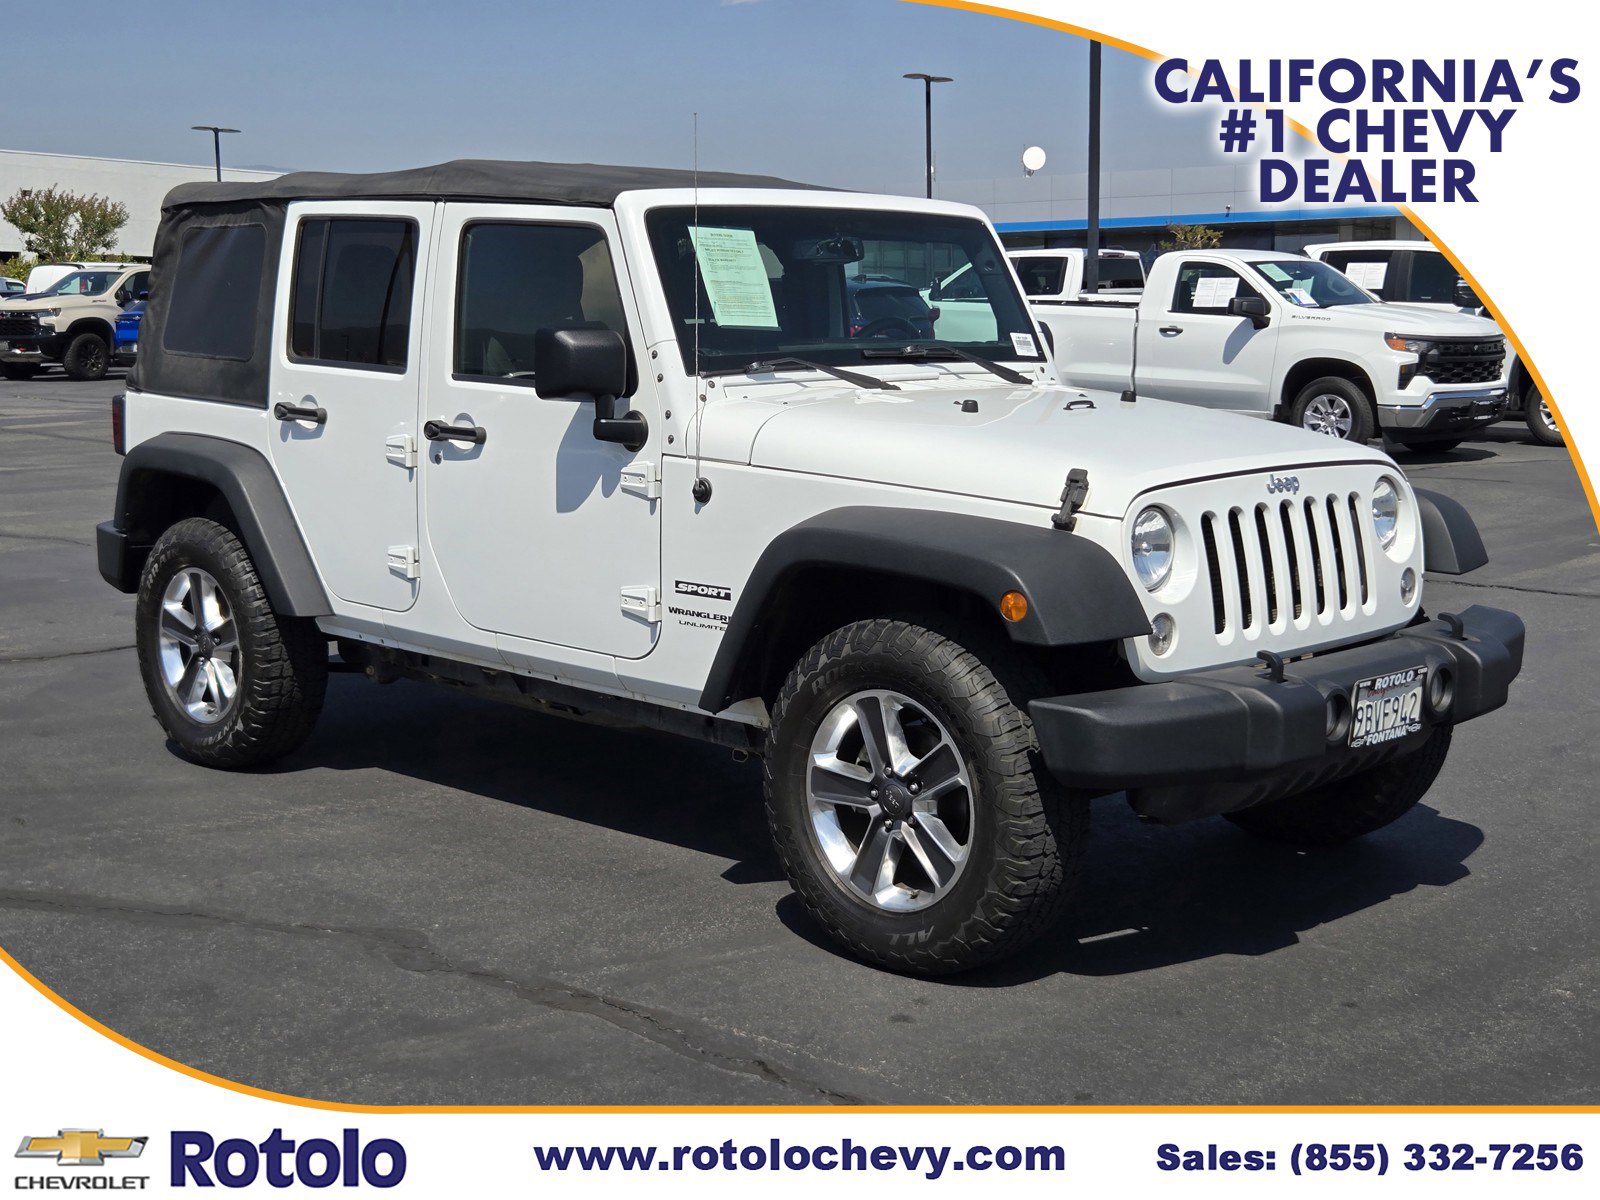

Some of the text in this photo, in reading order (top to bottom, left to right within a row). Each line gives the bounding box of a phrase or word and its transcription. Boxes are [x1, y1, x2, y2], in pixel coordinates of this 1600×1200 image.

[1265, 473, 1300, 495] Jeep
[677, 582, 729, 598] SPORT
[668, 606, 728, 622] WRANGLER
[679, 620, 727, 631] UNLIMITE
[1374, 670, 1415, 690] ROTOLO
[1353, 691, 1418, 738] 9BVF942
[1366, 727, 1408, 746] FONTANA
